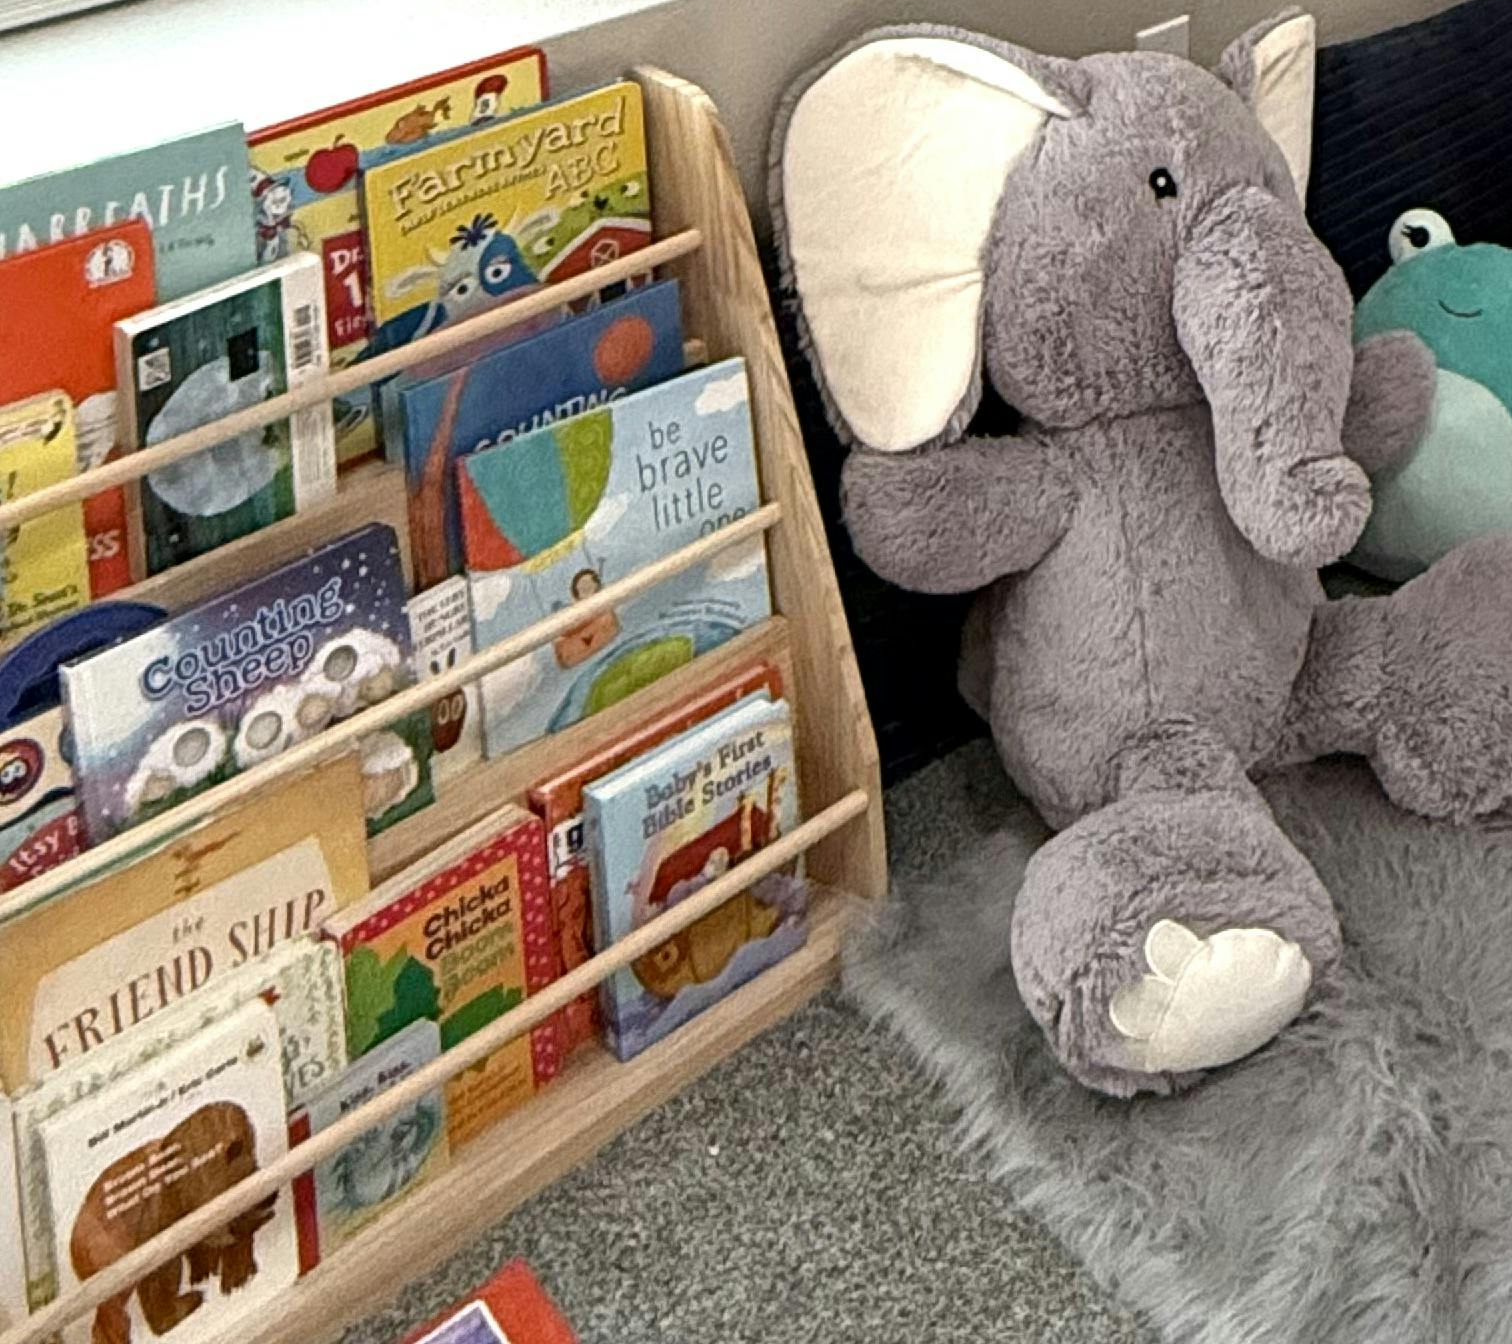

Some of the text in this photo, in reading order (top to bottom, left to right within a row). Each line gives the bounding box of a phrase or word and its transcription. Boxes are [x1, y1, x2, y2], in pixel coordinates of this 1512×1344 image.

[389, 96, 625, 220] Farmyard
[545, 140, 620, 200] ABC
[637, 434, 728, 493] brave
[648, 421, 680, 450] be
[653, 477, 723, 532] little
[142, 577, 344, 700] Counting
[186, 632, 313, 715] Sheep
[641, 755, 772, 840] Bible Stories
[643, 730, 766, 809] Baby's First
[9, 831, 59, 873] Itsy
[172, 915, 206, 943] the
[424, 875, 510, 938] Chicka
[425, 896, 512, 960] Chicka
[43, 889, 327, 1070] FRIEND SHIP
